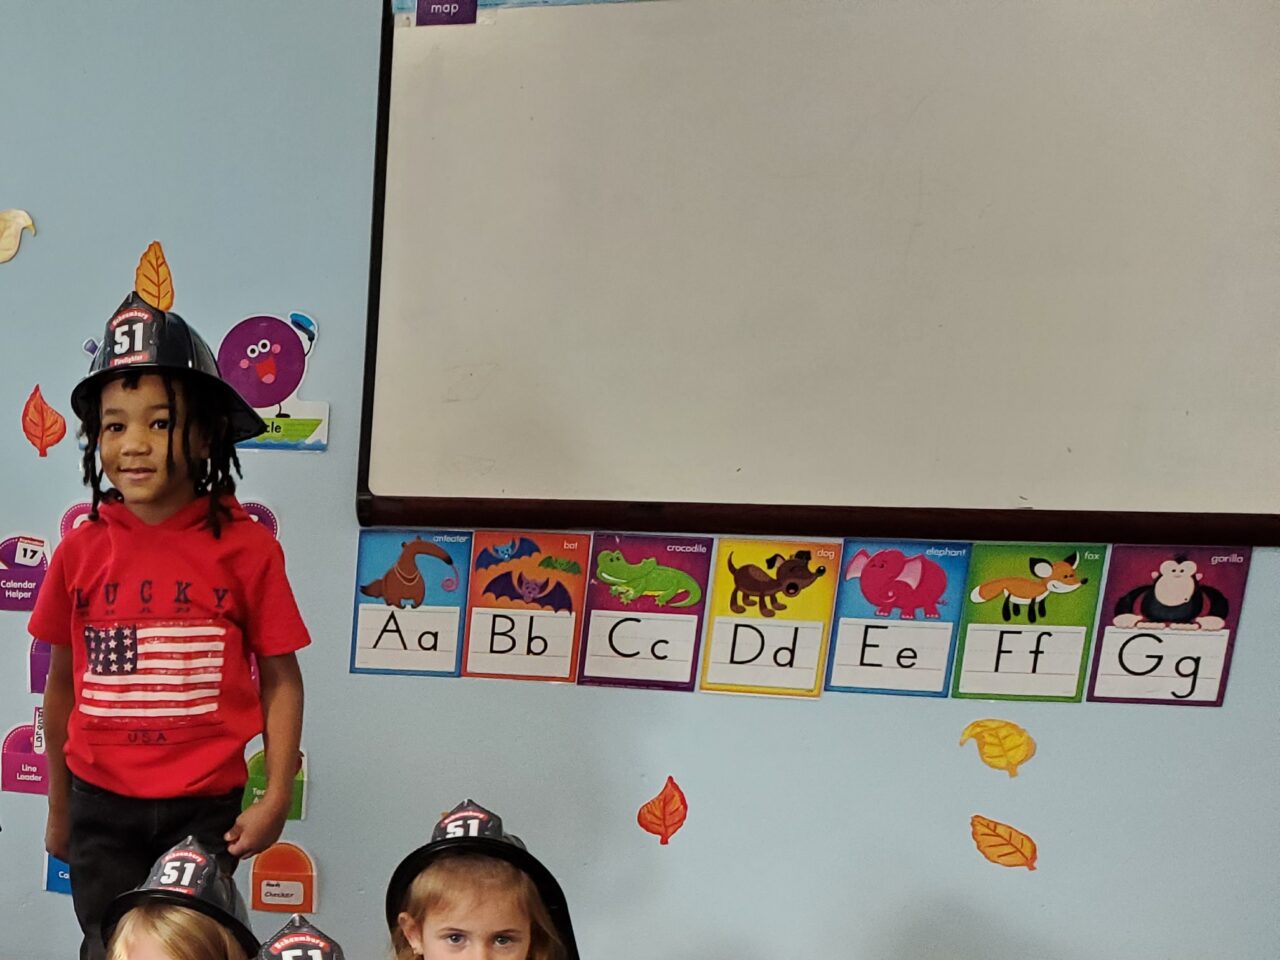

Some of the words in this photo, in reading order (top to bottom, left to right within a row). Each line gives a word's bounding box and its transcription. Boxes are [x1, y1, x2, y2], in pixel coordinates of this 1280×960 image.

[431, 3, 459, 16] map
[113, 322, 144, 355] 51
[432, 534, 470, 543] anteater
[563, 541, 578, 549] bat
[666, 544, 707, 553] crocodile
[22, 548, 39, 560] 17
[817, 549, 835, 560] dog
[926, 547, 967, 557] elephant
[1084, 552, 1100, 560] fox
[1211, 554, 1244, 565] gorilla
[0, 580, 37, 589] Calendar
[5, 589, 32, 600] Helper
[75, 579, 229, 609] LUCKY
[127, 732, 167, 744] USA
[21, 763, 37, 773] Line
[16, 772, 43, 782] Leader
[445, 819, 480, 839] 51
[160, 861, 196, 887] 51
